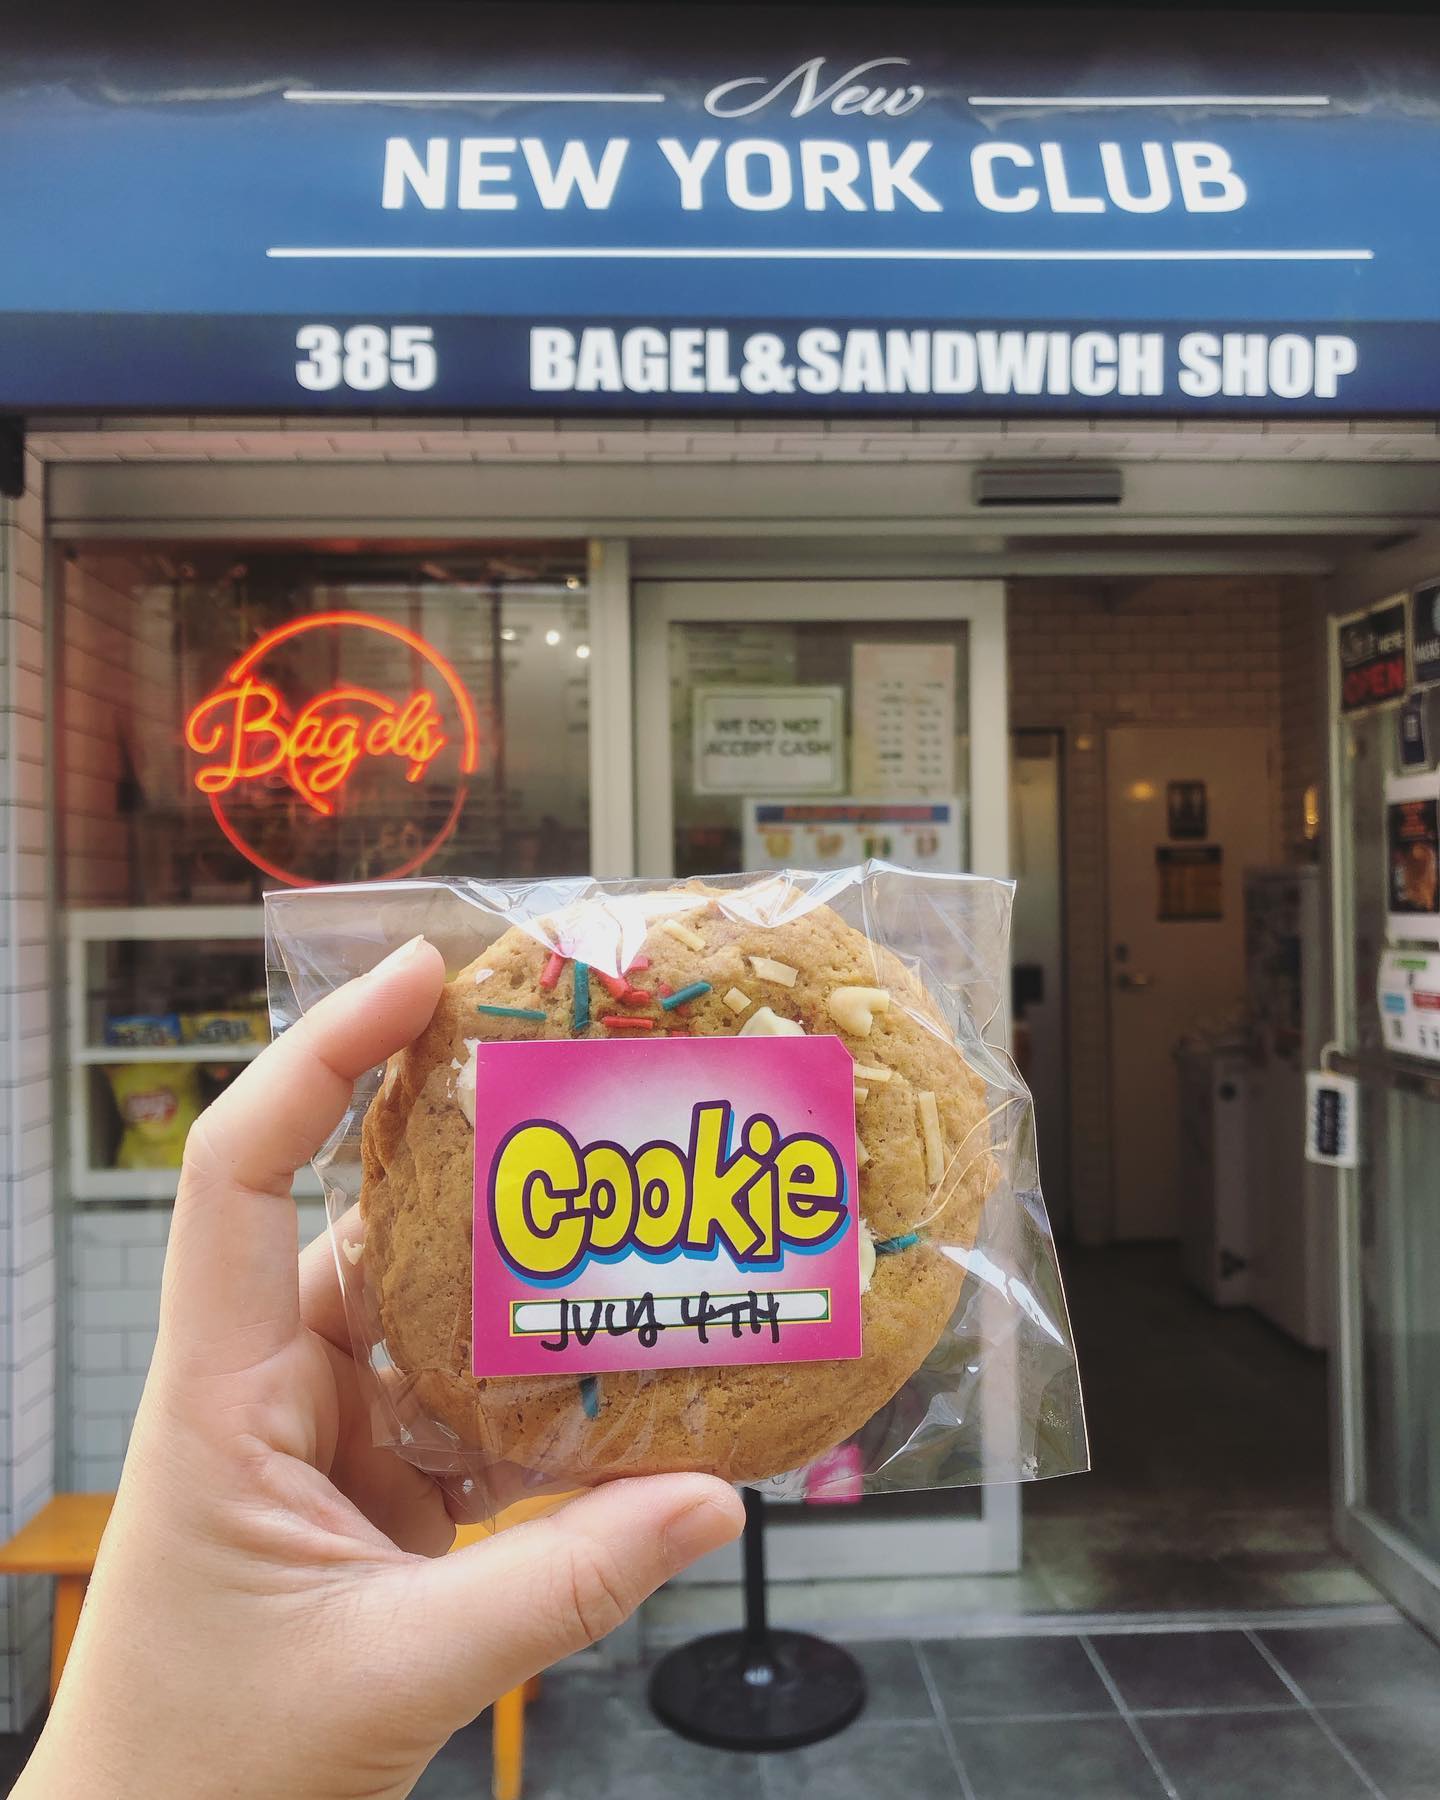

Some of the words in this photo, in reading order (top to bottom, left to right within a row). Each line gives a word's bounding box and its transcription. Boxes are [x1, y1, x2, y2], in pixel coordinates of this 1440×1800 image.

[704, 56, 925, 119] New
[382, 137, 630, 211] NEW
[657, 138, 944, 213] YORK
[969, 141, 1248, 214] CLUB
[295, 325, 438, 391] 385
[529, 326, 1165, 397] BAGEL&SANDWICH
[1178, 332, 1359, 399] SHOP
[1342, 655, 1406, 706] OPEN
[186, 676, 446, 812] Bagels
[704, 740, 774, 757] ACCEPT
[782, 718, 822, 735] NOT
[487, 1099, 852, 1288] Cookie
[680, 1290, 780, 1344] 4TH
